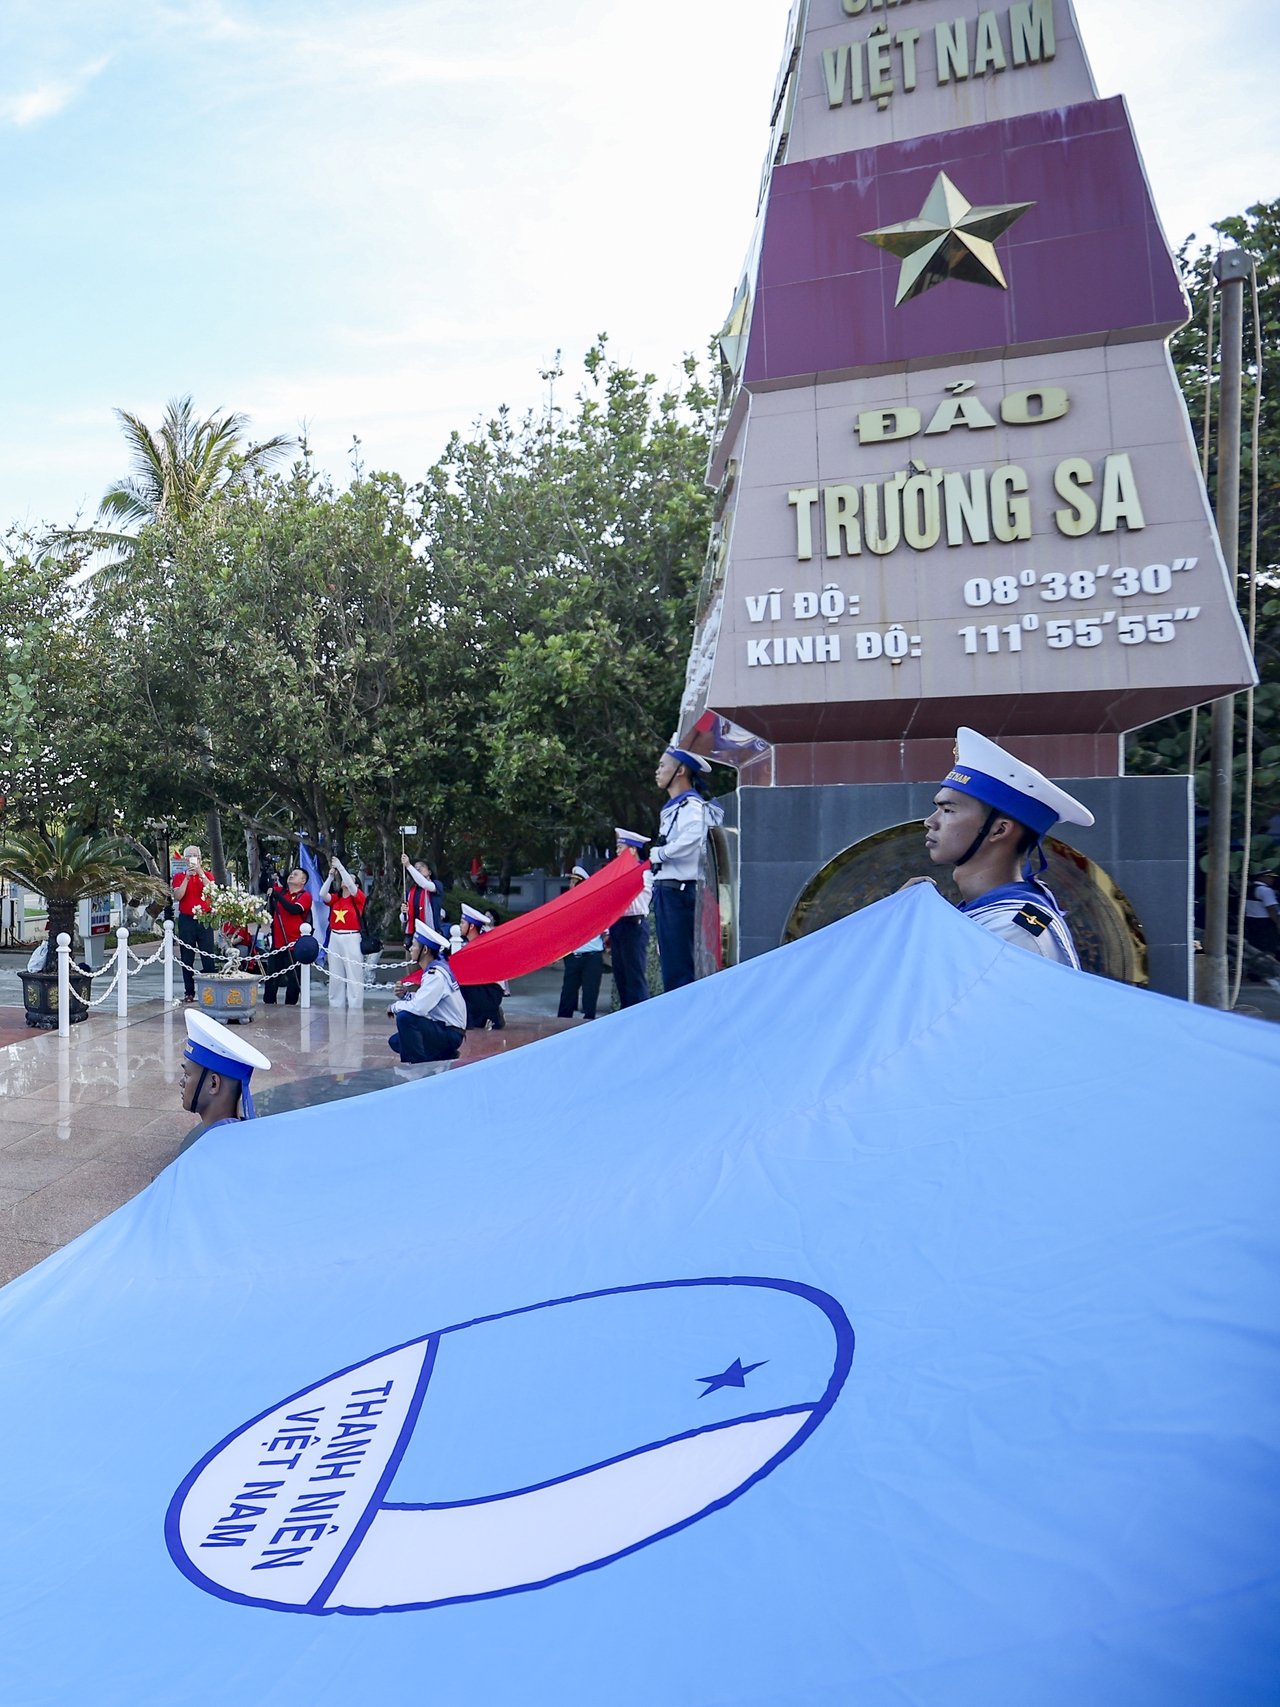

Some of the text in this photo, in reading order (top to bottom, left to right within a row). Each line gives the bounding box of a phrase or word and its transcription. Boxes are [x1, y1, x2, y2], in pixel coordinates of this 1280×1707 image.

[822, 21, 920, 112] VIỆT
[935, 0, 1056, 86] NAM
[853, 379, 1070, 446] ĐẢO
[787, 458, 1032, 561] TRƯỜNG
[1053, 452, 1147, 537] SA
[745, 587, 785, 623] VĨ
[793, 582, 860, 624] ĐỘ:
[746, 634, 841, 667] KINH
[855, 623, 922, 665] ĐỘ:
[199, 1406, 326, 1548] VIỆT NAM
[250, 1379, 394, 1571] THANH NIÊN
